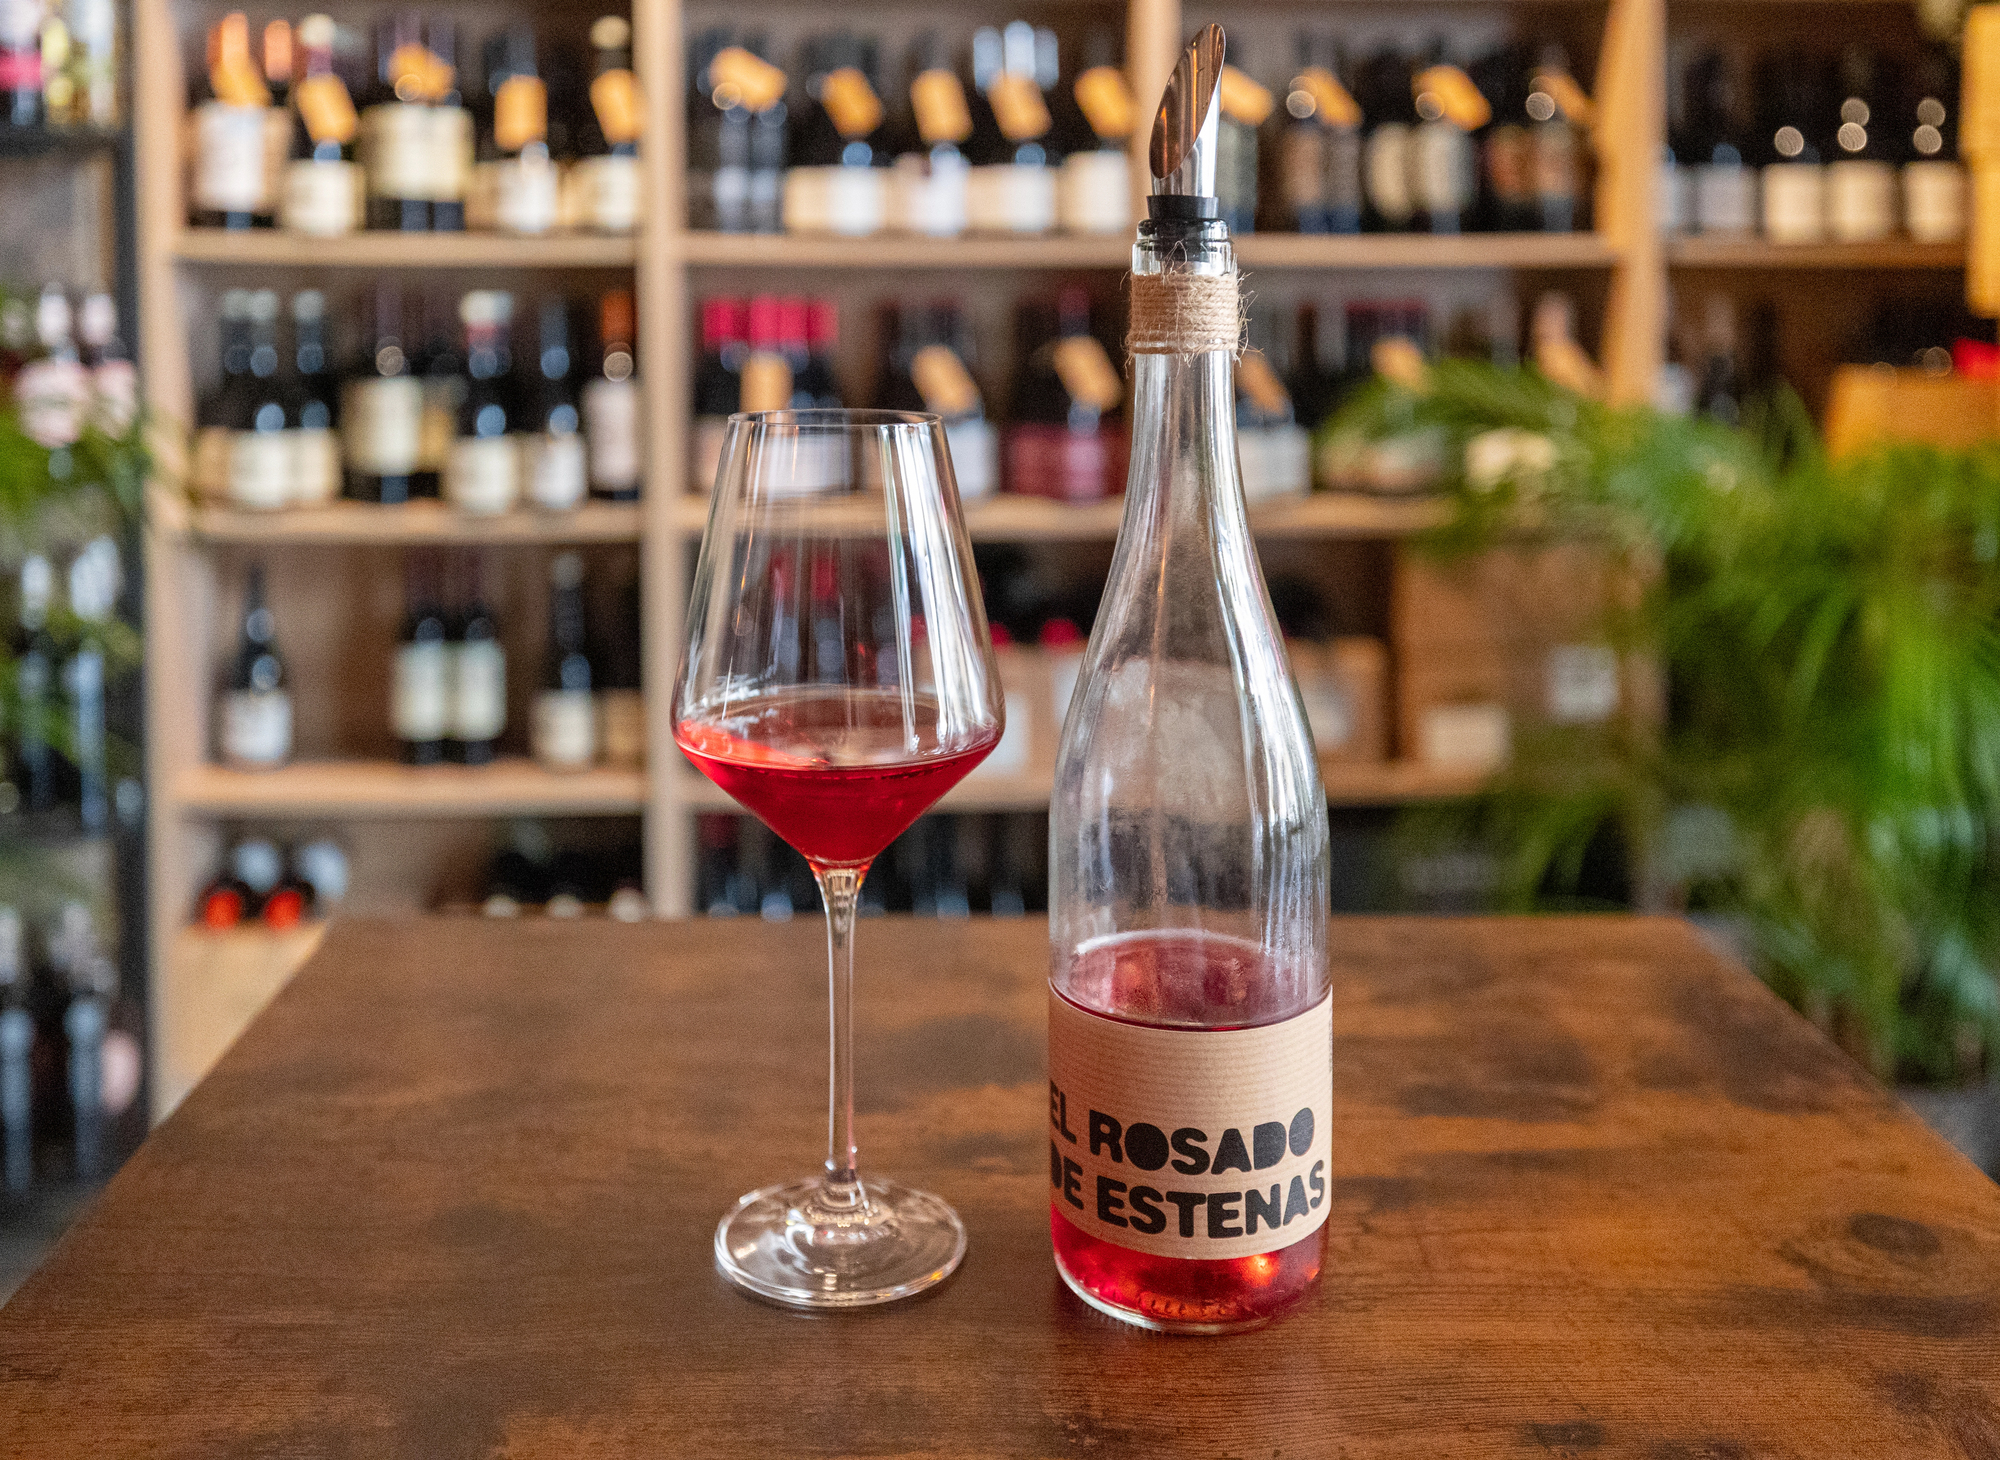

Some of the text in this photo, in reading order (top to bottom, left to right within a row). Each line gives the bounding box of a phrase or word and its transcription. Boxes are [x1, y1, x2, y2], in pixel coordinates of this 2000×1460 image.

[1050, 1079, 1315, 1175] EL ROSADO
[1096, 1159, 1325, 1239] ESTENAS
